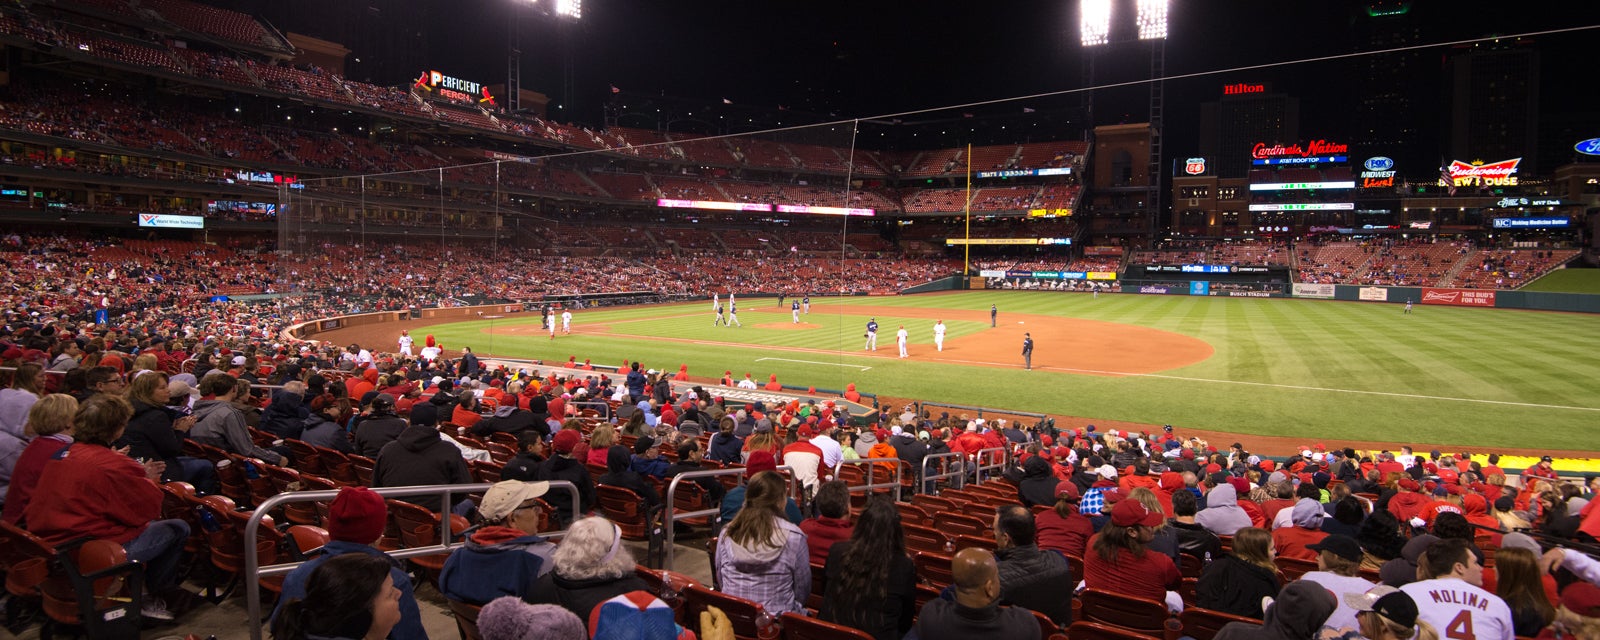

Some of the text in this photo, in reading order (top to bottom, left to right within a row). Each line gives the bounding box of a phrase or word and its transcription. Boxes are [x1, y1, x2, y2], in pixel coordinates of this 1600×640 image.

[430, 70, 480, 94] PERFICIENT
[1224, 84, 1264, 94] Hilton
[440, 88, 470, 101] PERCH
[1252, 140, 1347, 158] Cardinals Nation
[1440, 166, 1518, 176] Budweiser
[1438, 178, 1472, 187] BEW
[1429, 590, 1488, 611] MOLINA
[1446, 609, 1476, 640] 4
